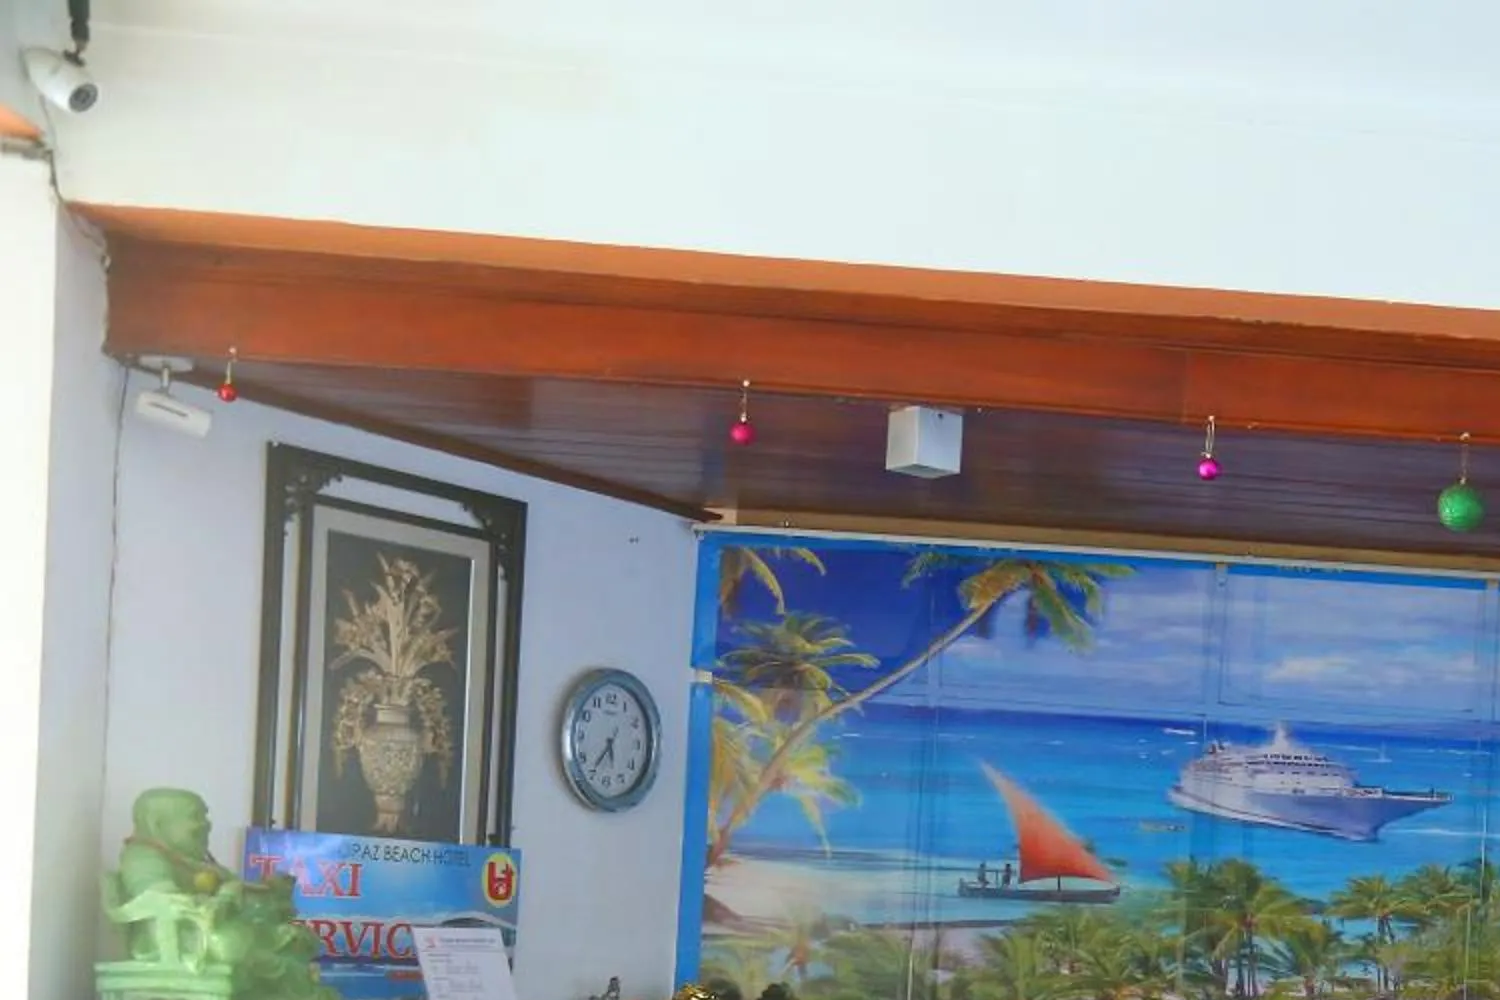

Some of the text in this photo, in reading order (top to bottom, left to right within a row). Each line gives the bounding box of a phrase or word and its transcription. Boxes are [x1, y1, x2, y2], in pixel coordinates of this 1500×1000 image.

[383, 845, 431, 864] BEACH
[249, 854, 363, 897] TAXI
[287, 918, 417, 959] RVIC
